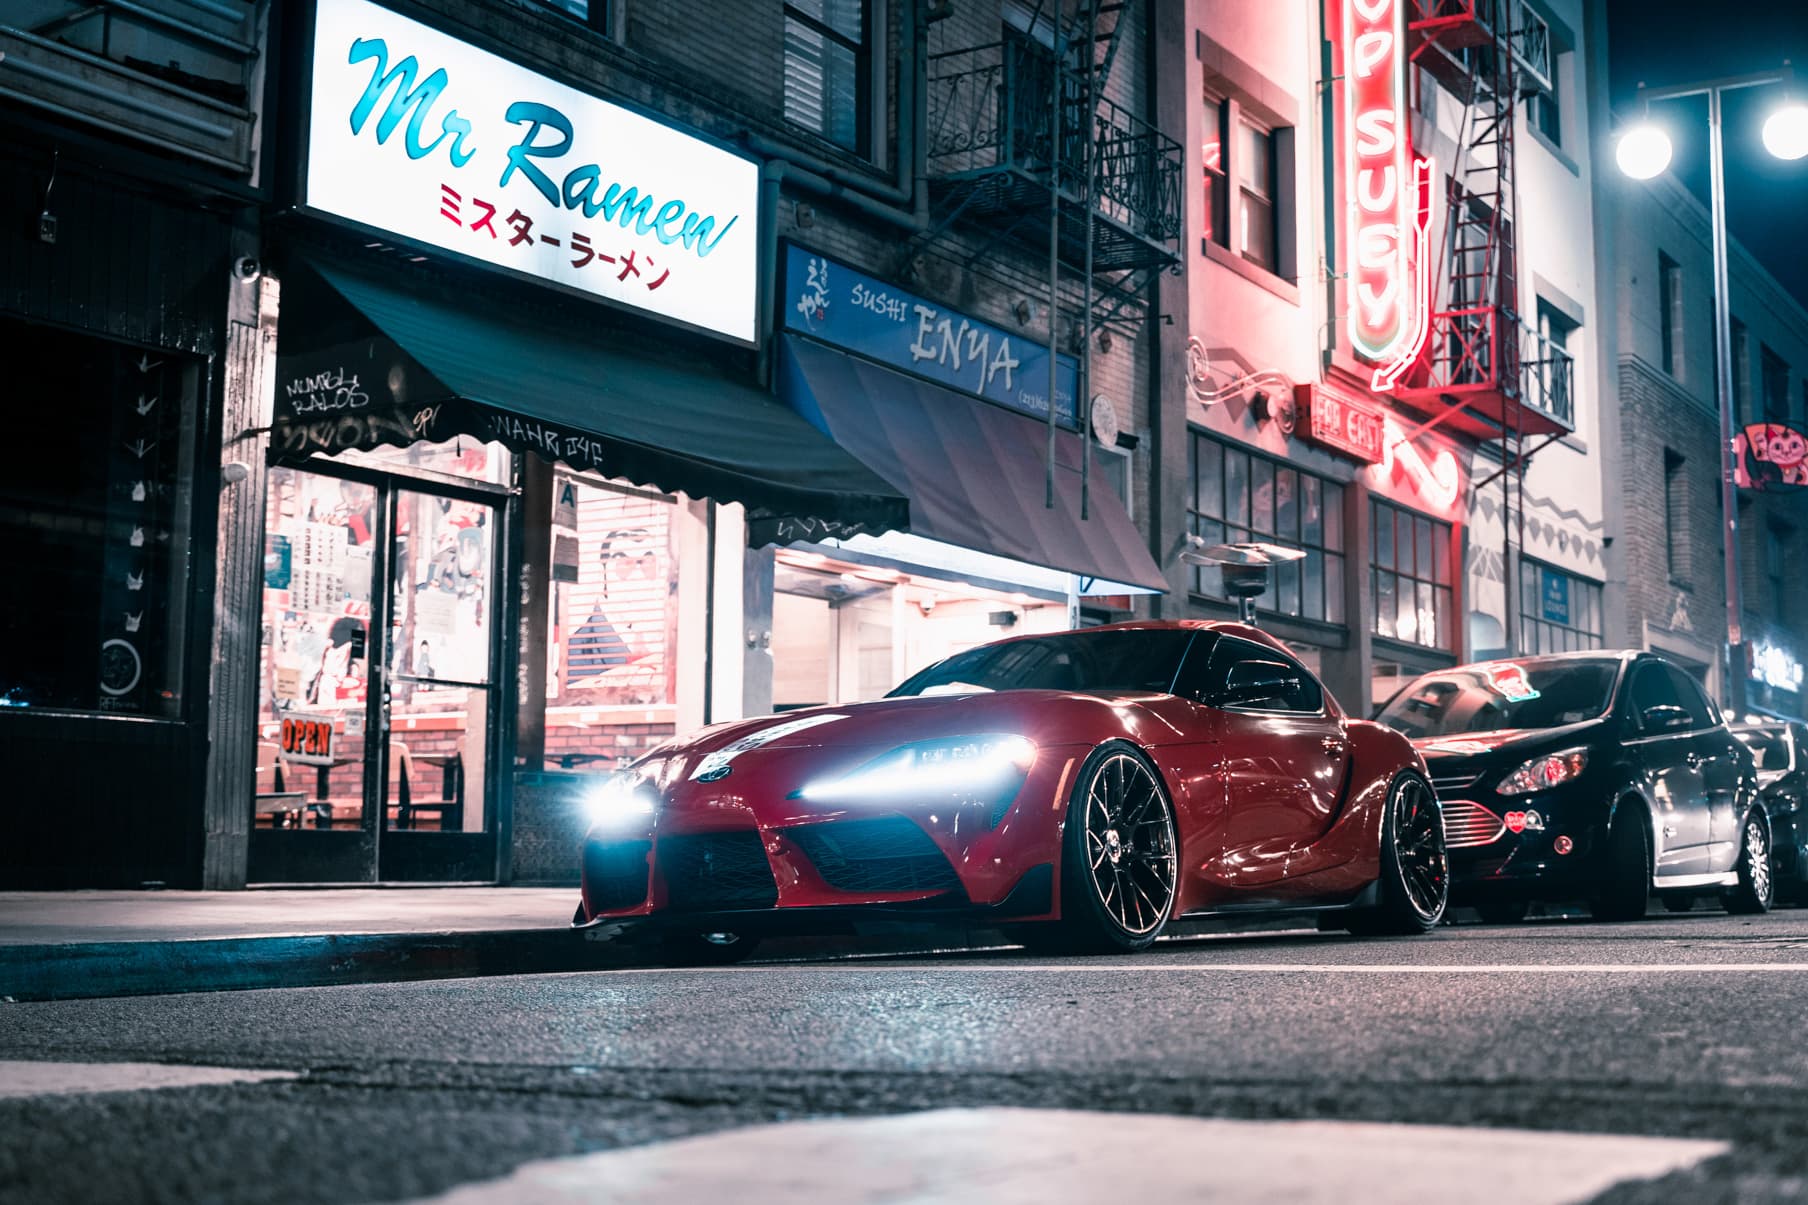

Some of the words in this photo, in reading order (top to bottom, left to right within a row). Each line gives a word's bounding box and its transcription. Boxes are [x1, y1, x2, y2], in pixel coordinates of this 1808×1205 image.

[349, 37, 477, 168] Mr
[499, 101, 739, 258] Ramen
[440, 183, 671, 292] ミスターラーメン
[1355, 108, 1400, 327] SUEY
[850, 282, 908, 323] SUSHI
[909, 303, 1020, 396] ENYA
[1346, 409, 1381, 452] EAST
[560, 482, 575, 508] A
[282, 718, 332, 757] OPEN
